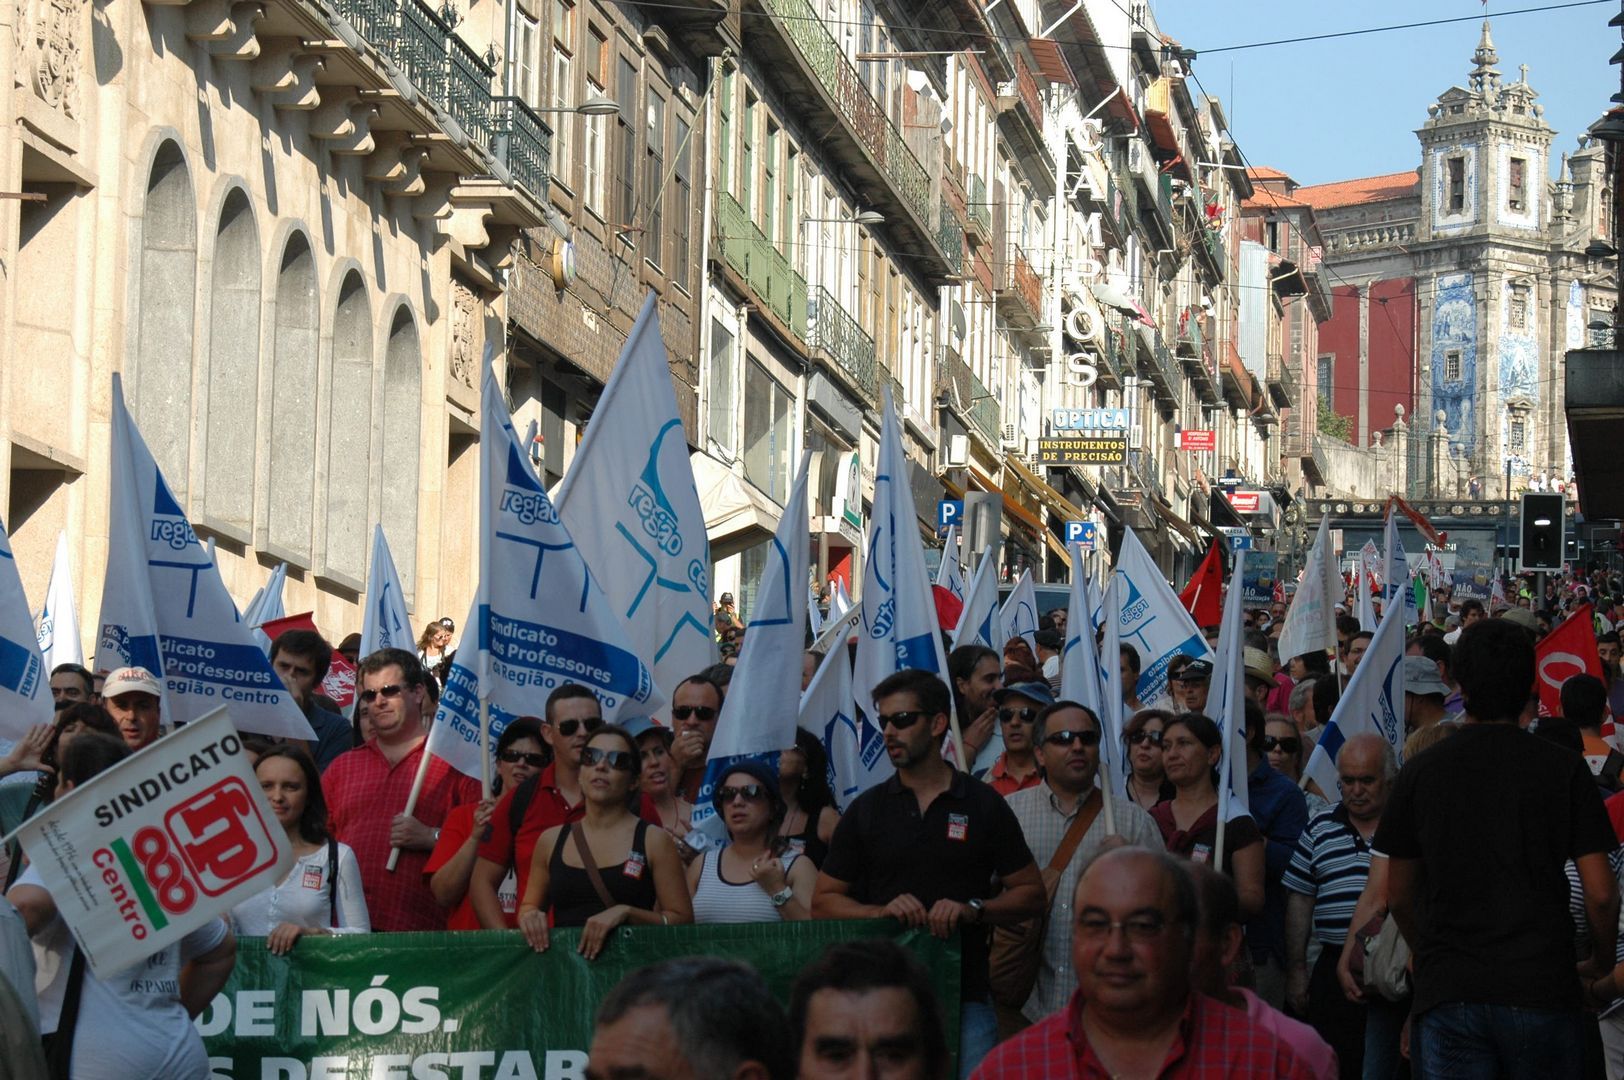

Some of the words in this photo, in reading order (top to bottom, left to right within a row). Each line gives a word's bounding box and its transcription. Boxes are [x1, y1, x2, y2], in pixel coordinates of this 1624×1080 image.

[1066, 118, 1107, 387] CAMPOS
[1039, 441, 1125, 450] INSTRUMENTOS
[1043, 452, 1058, 461] DE
[1064, 450, 1123, 461] PRECISÃO
[627, 485, 683, 557] região
[942, 503, 956, 523] P
[1069, 523, 1083, 540] P
[1233, 537, 1243, 548] P
[490, 616, 558, 647] Sindicato
[161, 639, 216, 660] dicato
[166, 657, 271, 683] Professores
[501, 665, 556, 689] Região
[507, 644, 612, 684] Professores
[167, 678, 215, 697] egião
[221, 687, 279, 705] Centro
[94, 734, 241, 828] SINDICATO
[192, 989, 276, 1038] DE
[301, 974, 459, 1038] NÓS.
